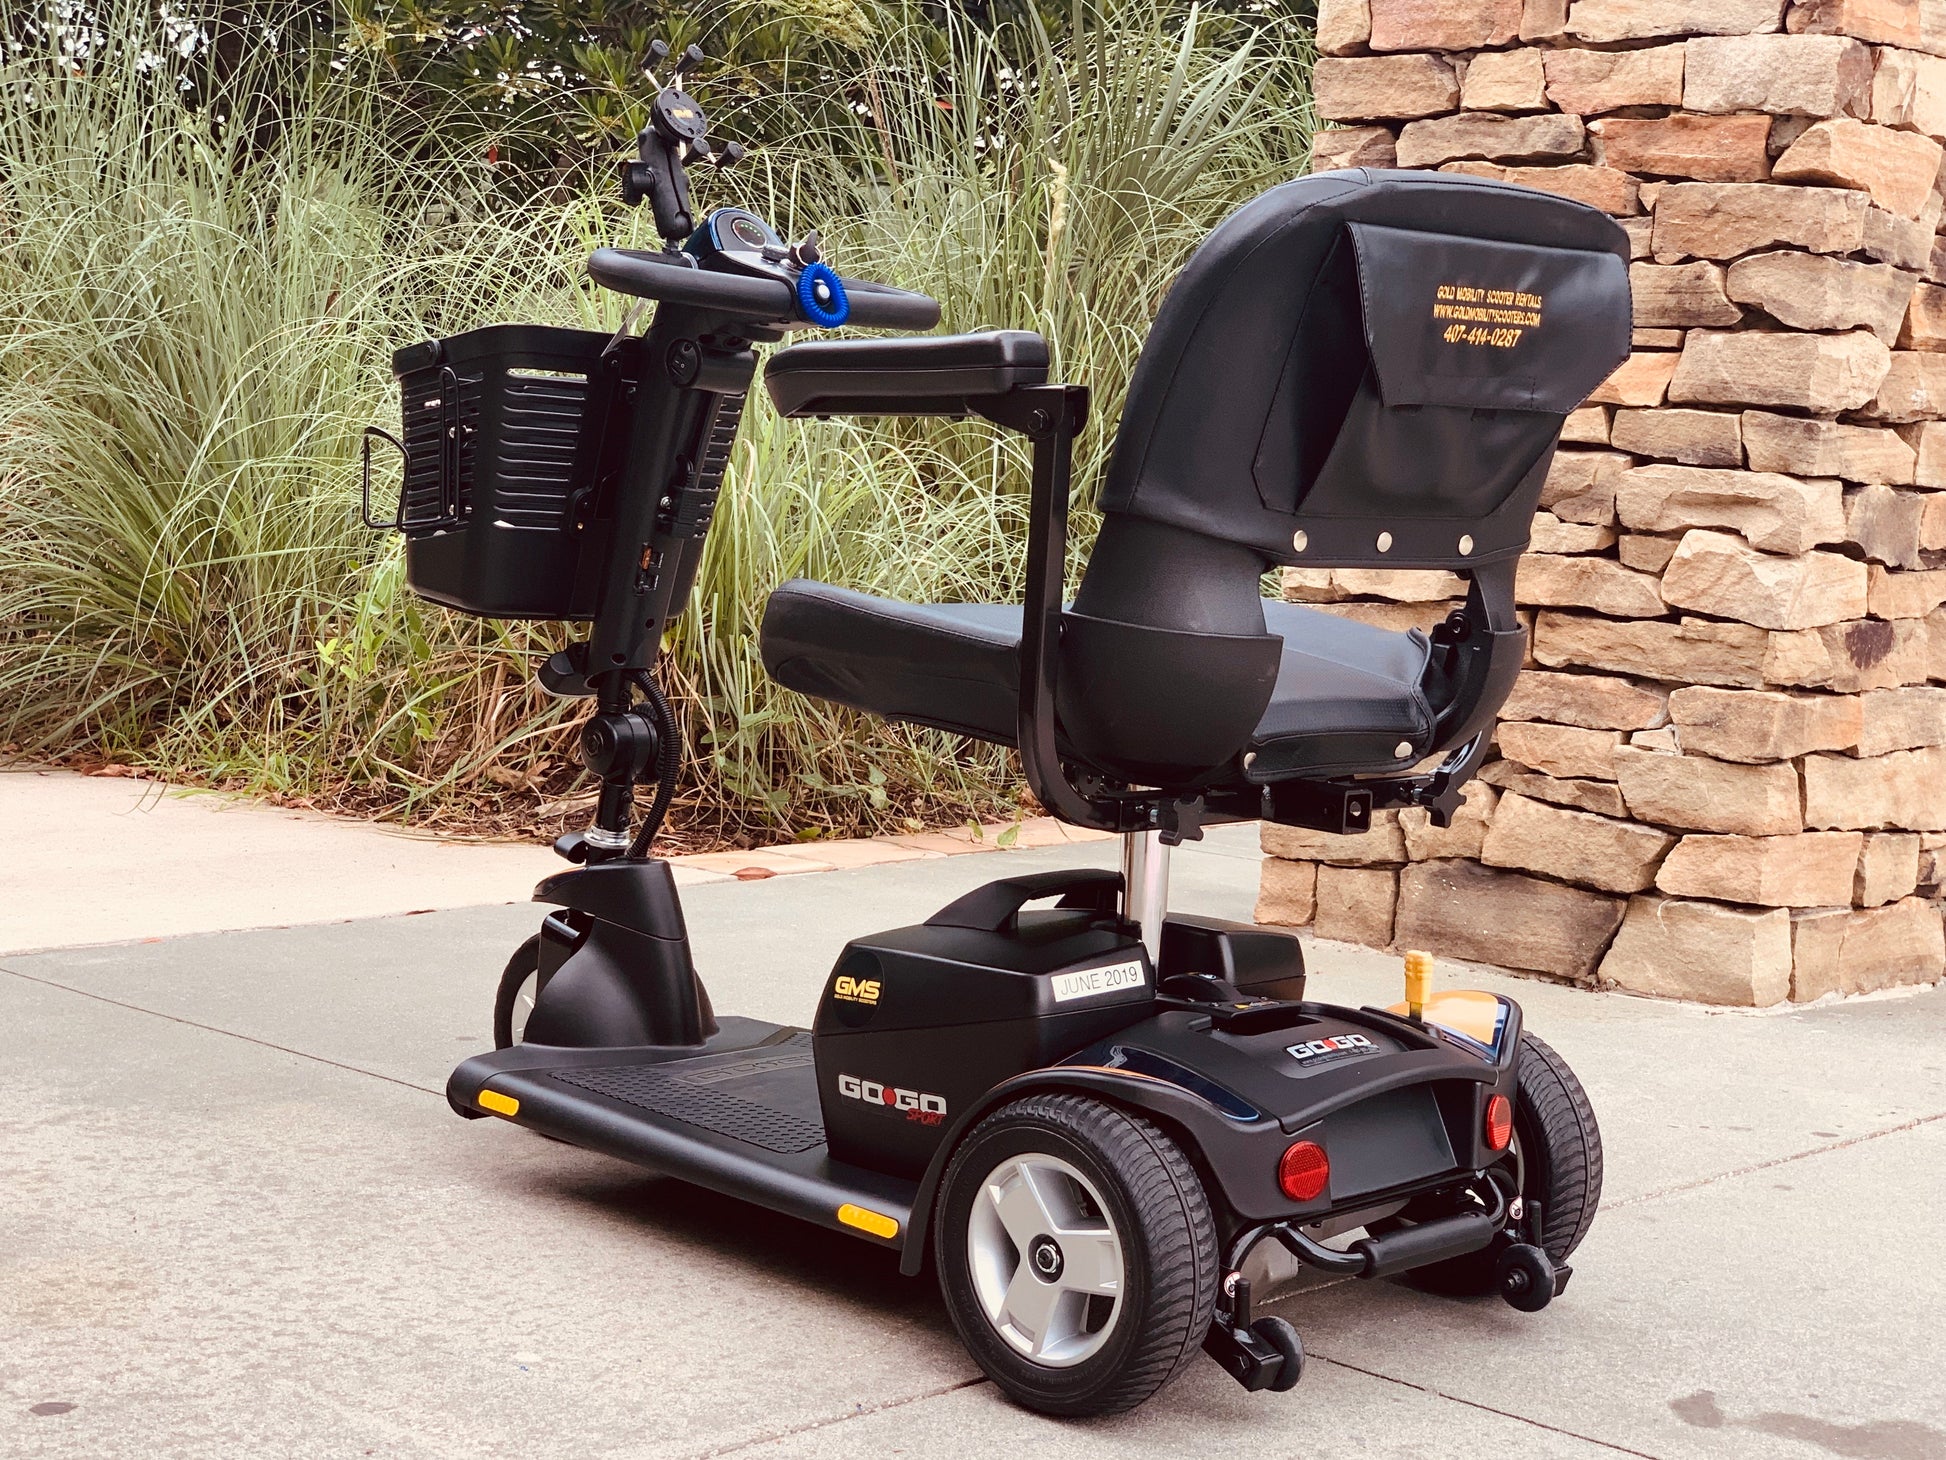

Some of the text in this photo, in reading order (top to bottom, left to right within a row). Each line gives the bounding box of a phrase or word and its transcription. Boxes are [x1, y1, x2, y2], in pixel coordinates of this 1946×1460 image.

[1437, 285, 1542, 309] GOLD MOBILITY SCOOTER RENTALS
[1443, 324, 1522, 347] 407-414-0287
[834, 975, 881, 1000] GMS
[1061, 966, 1138, 995] JUNE 2019
[906, 1107, 946, 1127] SPORT
